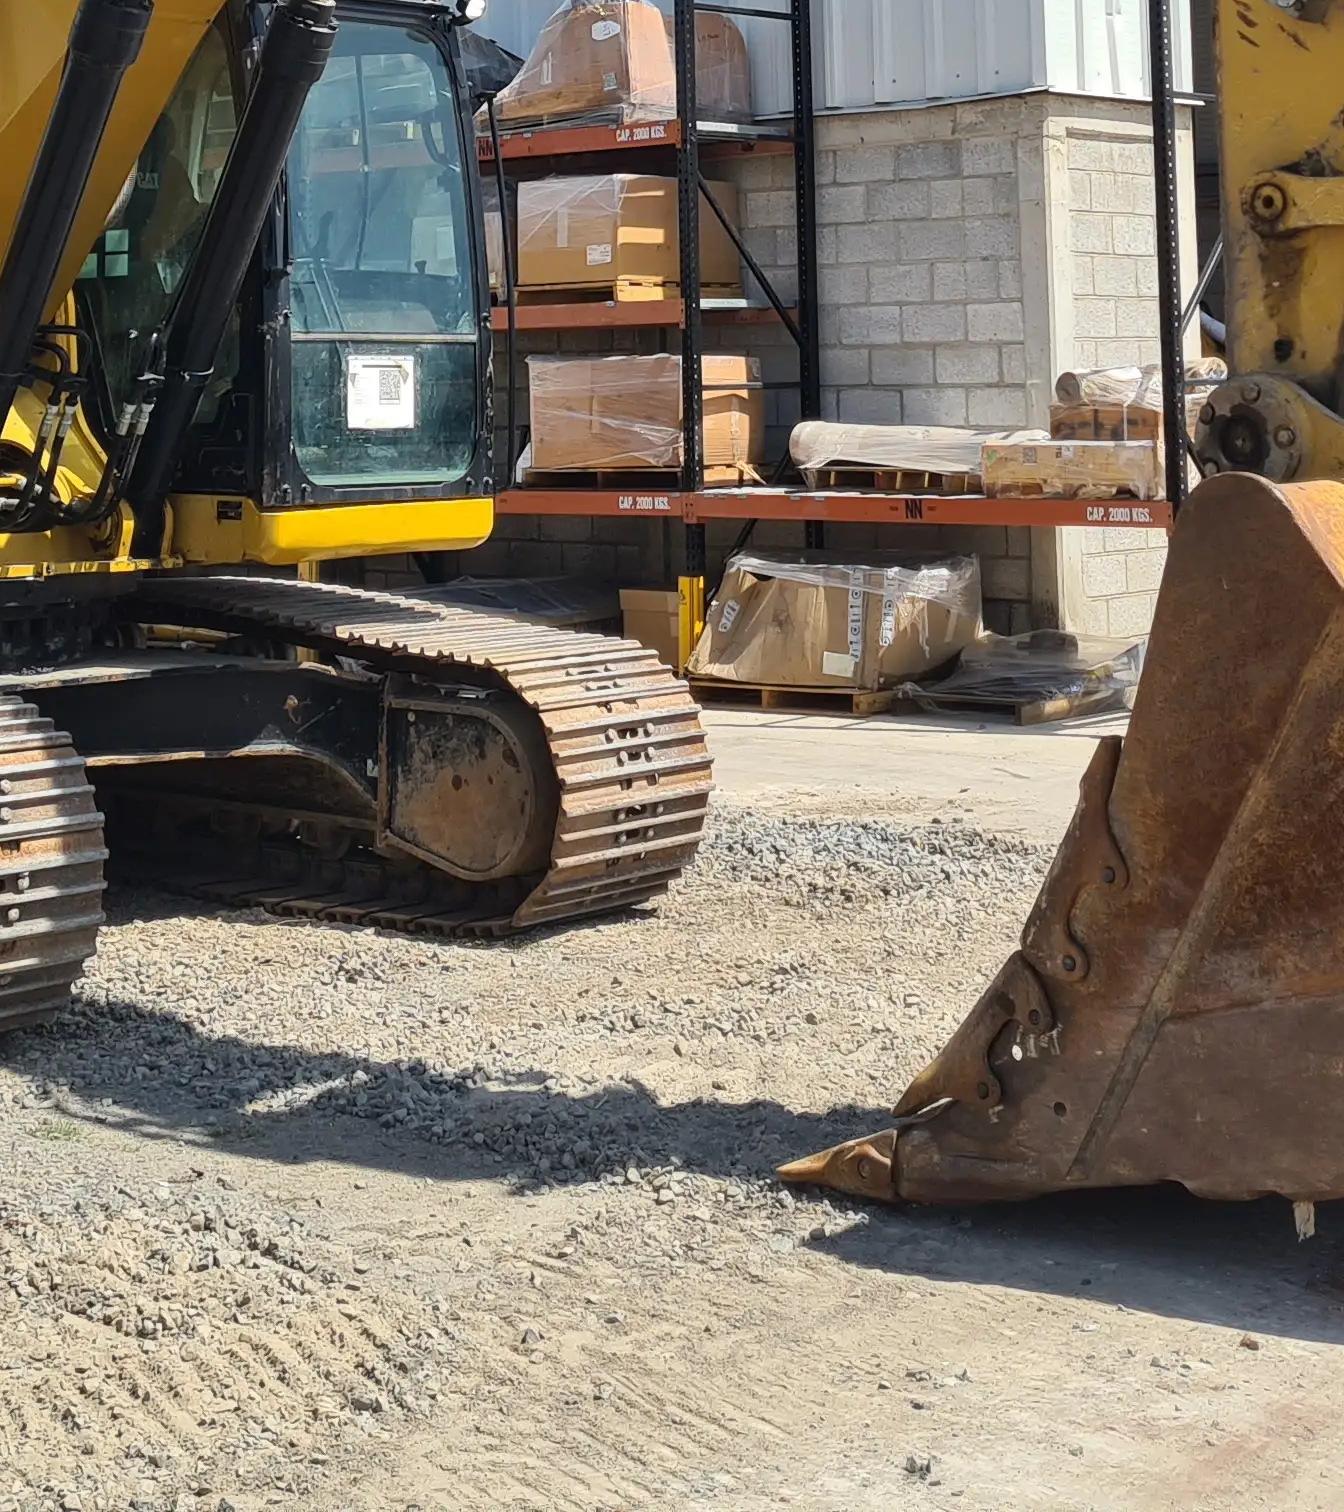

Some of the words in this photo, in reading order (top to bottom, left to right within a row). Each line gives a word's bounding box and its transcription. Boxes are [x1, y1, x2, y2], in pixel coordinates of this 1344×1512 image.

[633, 127, 649, 141] 2000
[618, 496, 635, 509] CAP.
[636, 496, 653, 510] 2000
[1086, 506, 1107, 522] CAP.
[1108, 507, 1130, 522] 2000
[1131, 507, 1154, 523] KGS.
